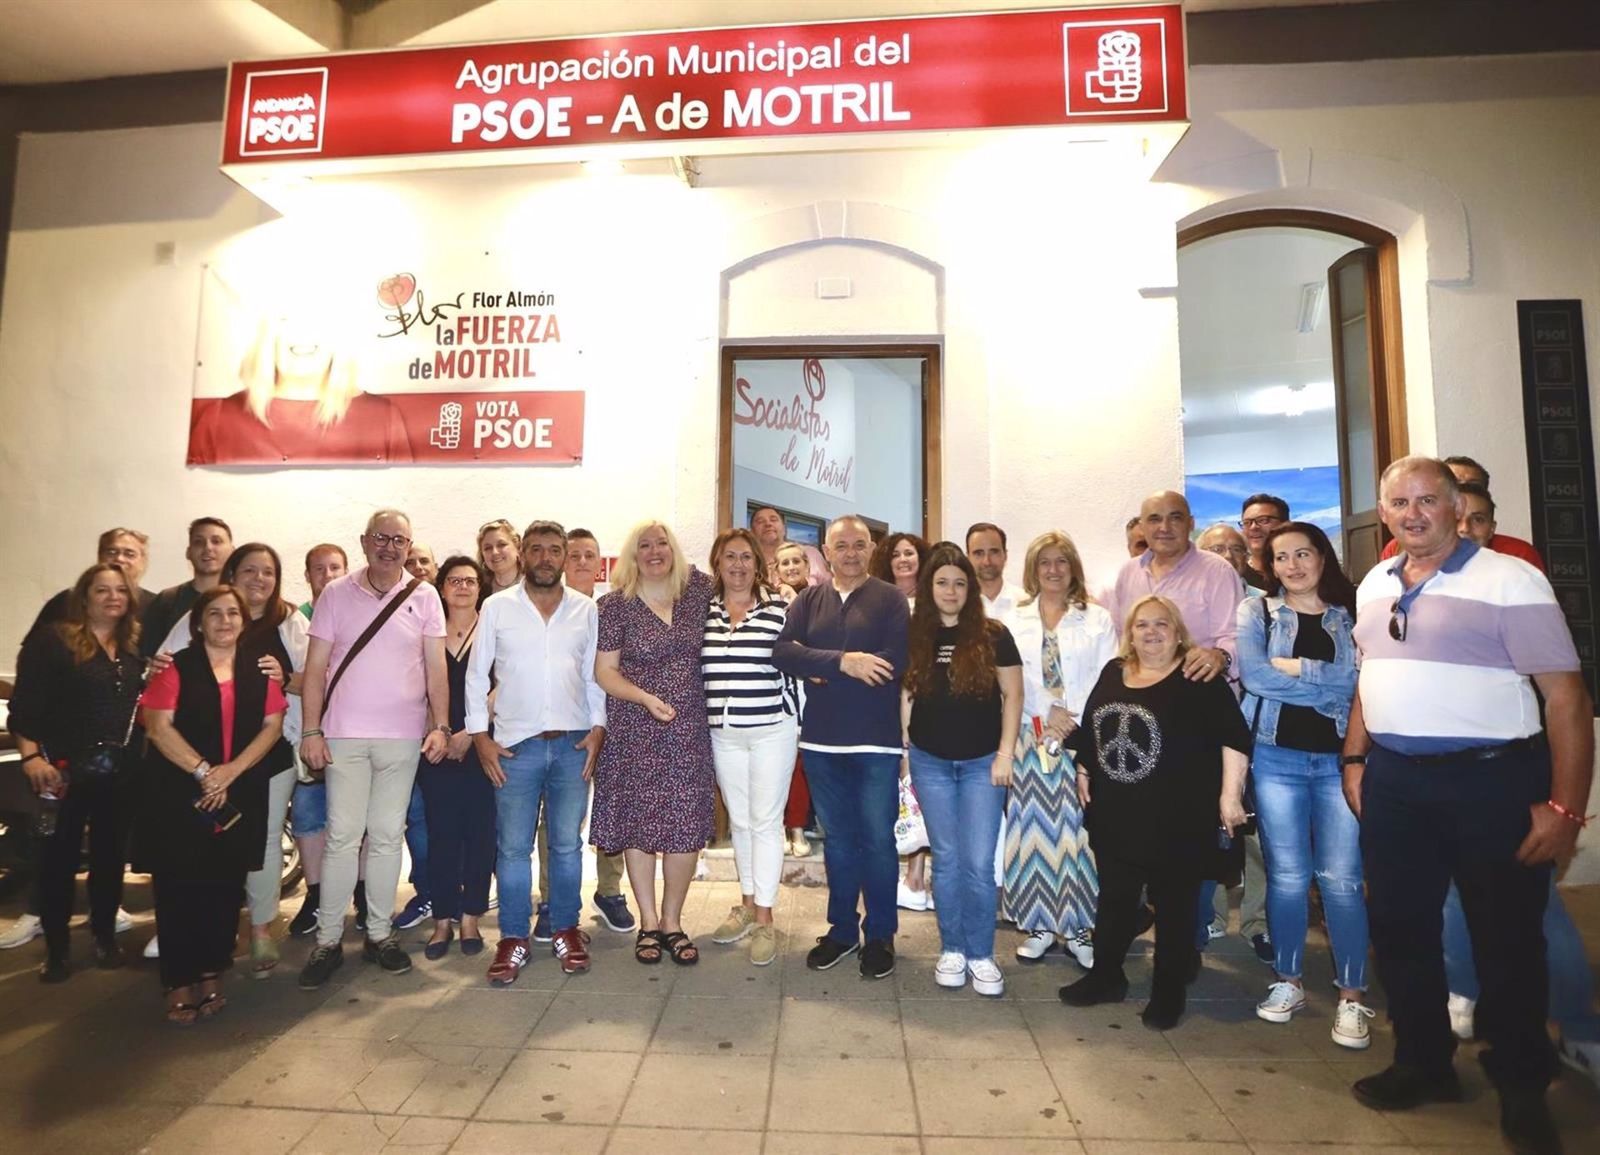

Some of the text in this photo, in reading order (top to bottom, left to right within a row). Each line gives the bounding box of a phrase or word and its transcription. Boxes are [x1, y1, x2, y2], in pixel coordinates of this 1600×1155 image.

[455, 33, 910, 94] Agrupación Municipal del
[451, 96, 573, 143] PSOE
[610, 94, 646, 134] A
[655, 92, 709, 131] de
[724, 81, 911, 128] MOTRIL
[249, 114, 316, 144] PSOE
[472, 290, 555, 308] Flor Almón
[1536, 329, 1567, 341] PSOE
[476, 400, 520, 417] VOTA
[734, 377, 830, 442] Socialistas
[1542, 406, 1573, 417] PSOE
[474, 418, 553, 448] PSOE
[779, 434, 853, 494] de Motril
[1548, 484, 1580, 496] PSOE
[1552, 563, 1585, 575] PSOE
